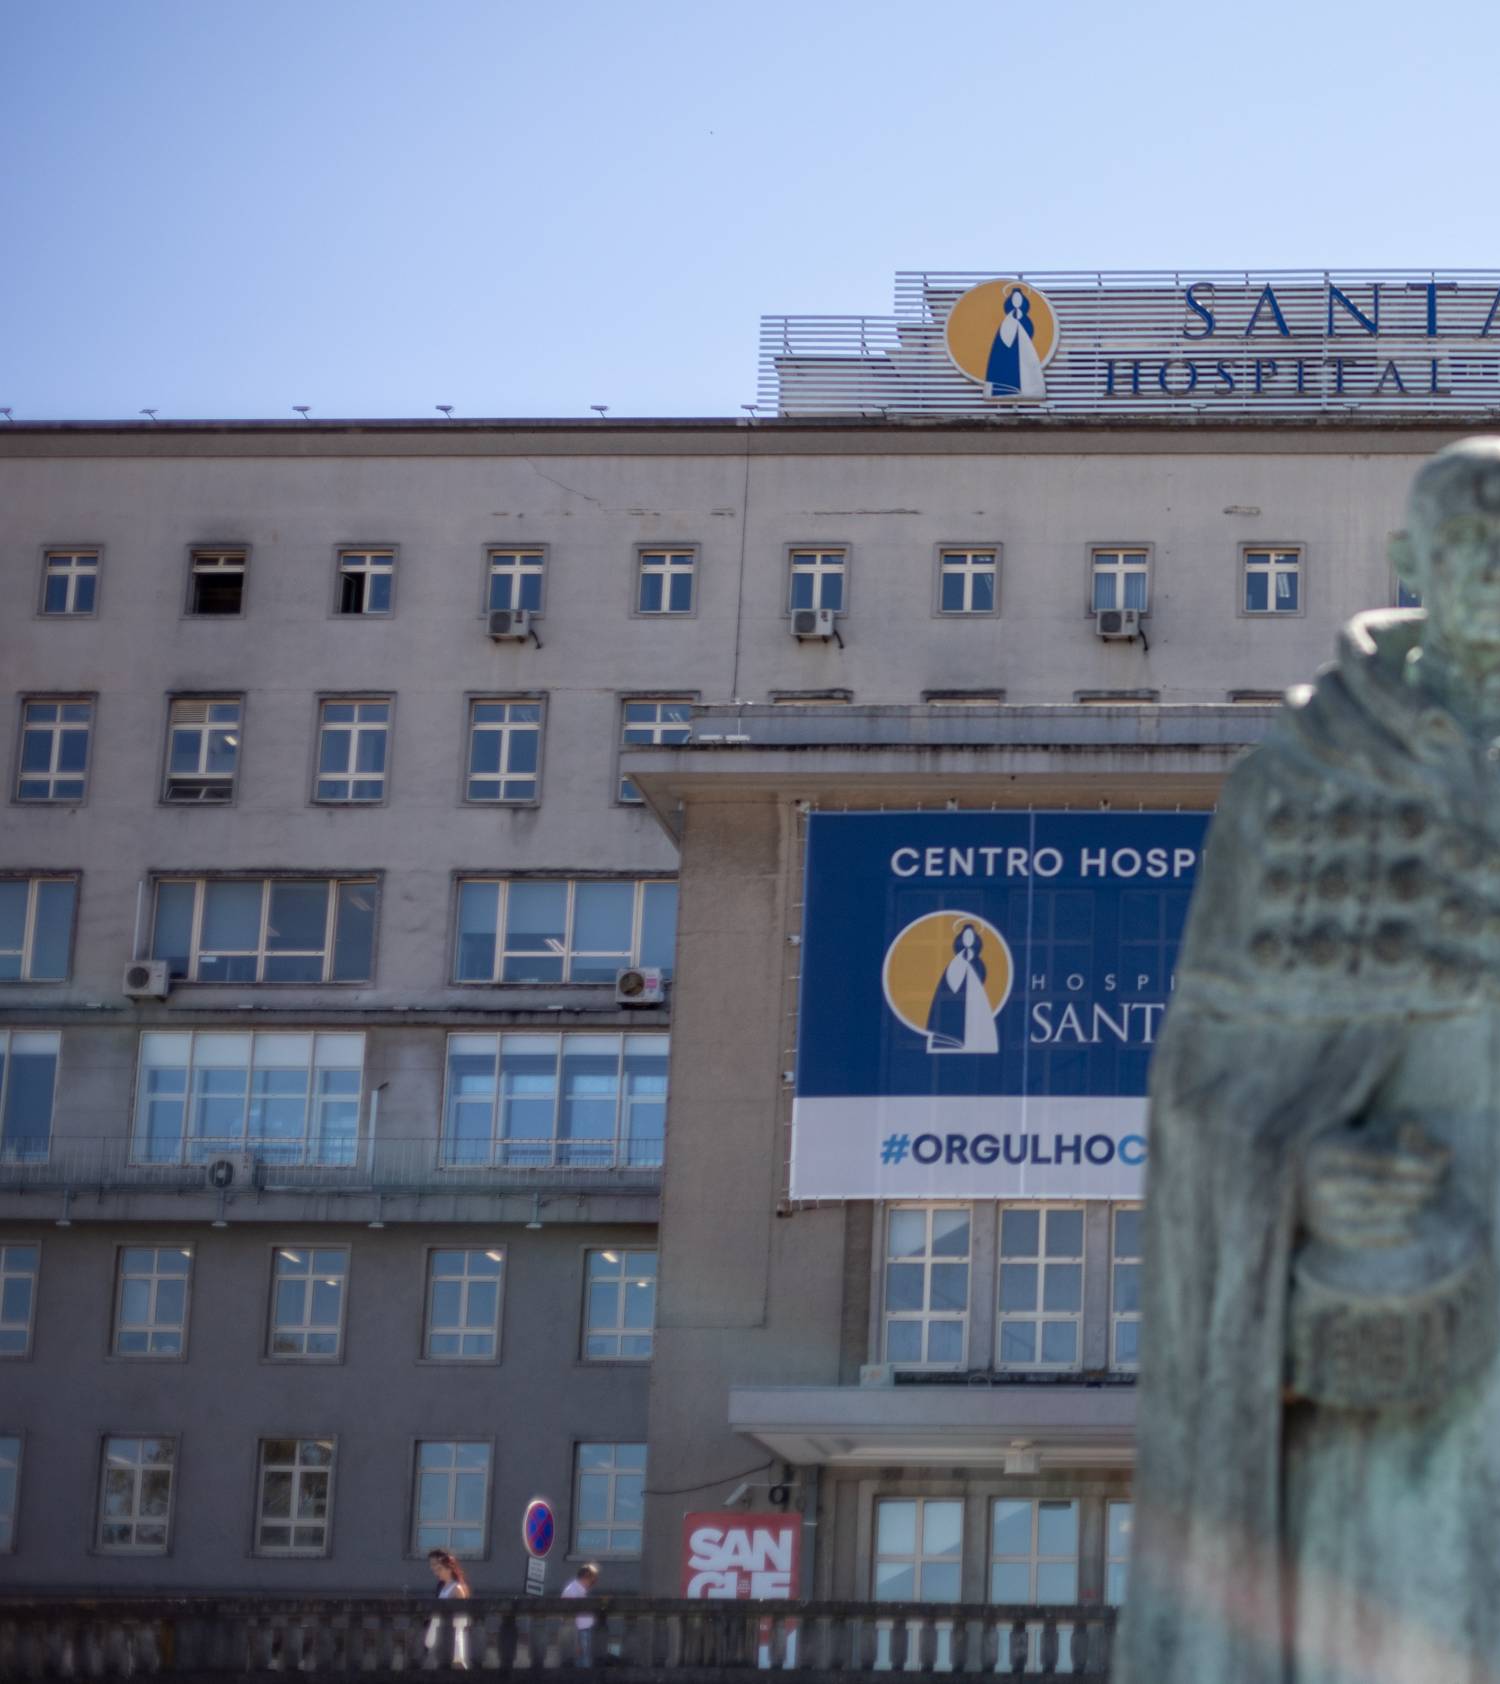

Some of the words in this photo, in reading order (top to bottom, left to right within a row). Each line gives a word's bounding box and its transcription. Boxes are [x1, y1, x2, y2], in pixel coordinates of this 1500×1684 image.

[1104, 358, 1451, 397] HOSPITAL
[890, 847, 1064, 878] CENTRO
[1031, 973, 1176, 991] HOSPI
[1030, 1001, 1166, 1043] SANT
[881, 1132, 1149, 1167] #ORGULHOC
[687, 1527, 792, 1571] SAN
